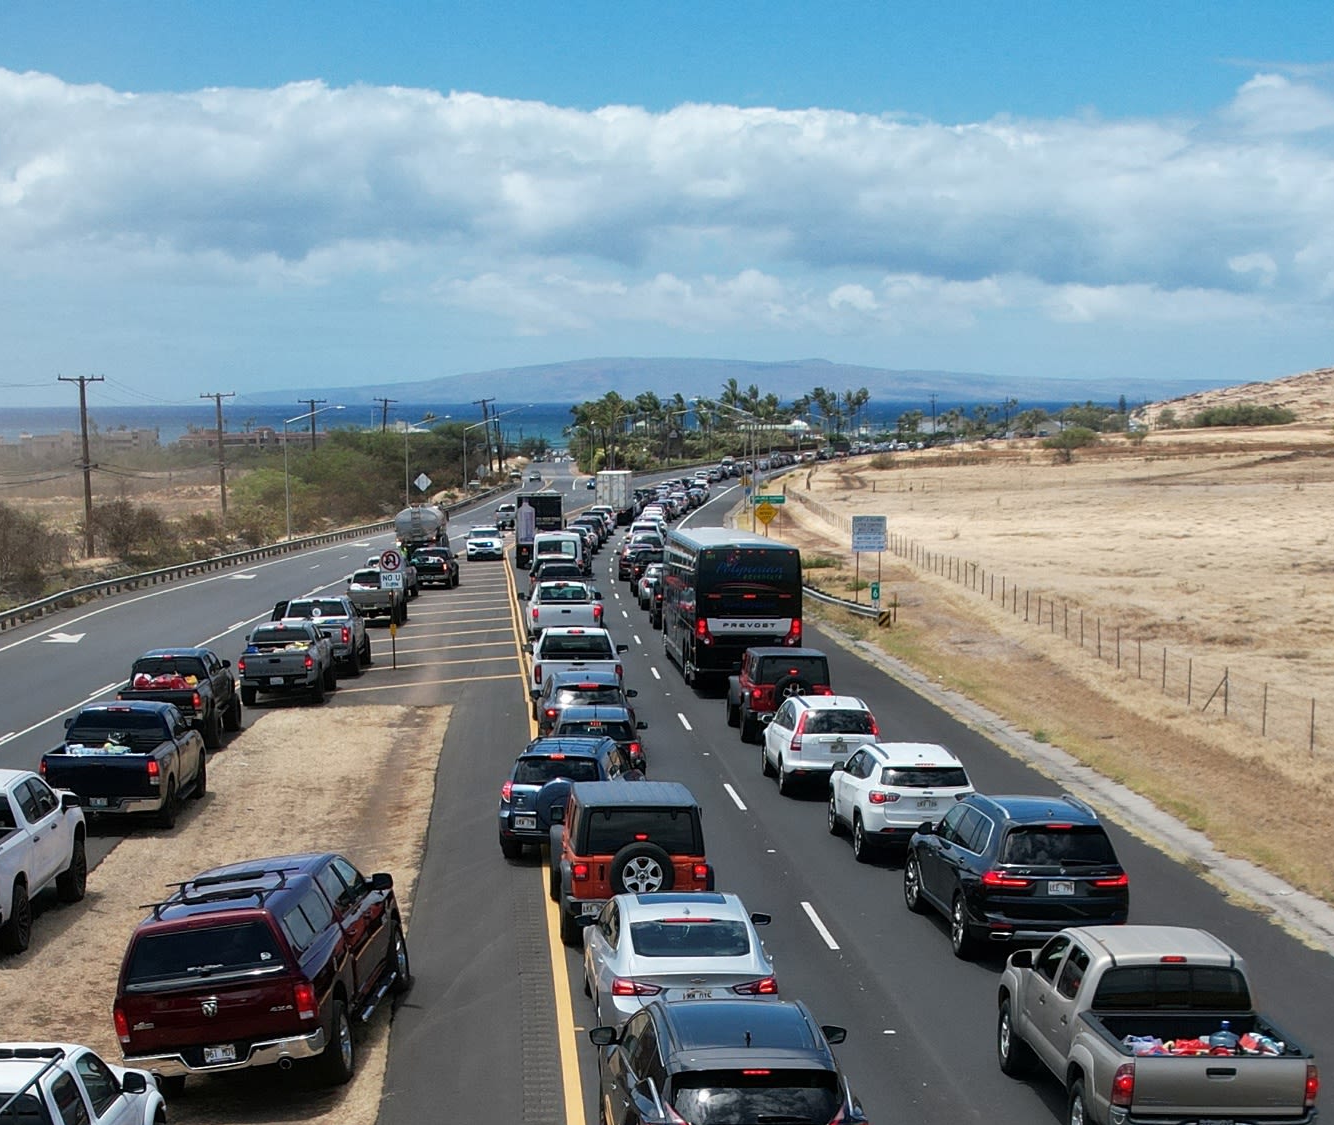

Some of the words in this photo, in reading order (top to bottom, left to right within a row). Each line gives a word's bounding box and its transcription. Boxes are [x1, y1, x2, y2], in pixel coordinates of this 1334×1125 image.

[382, 574, 393, 582] NO
[395, 574, 401, 582] U
[872, 588, 878, 598] 6
